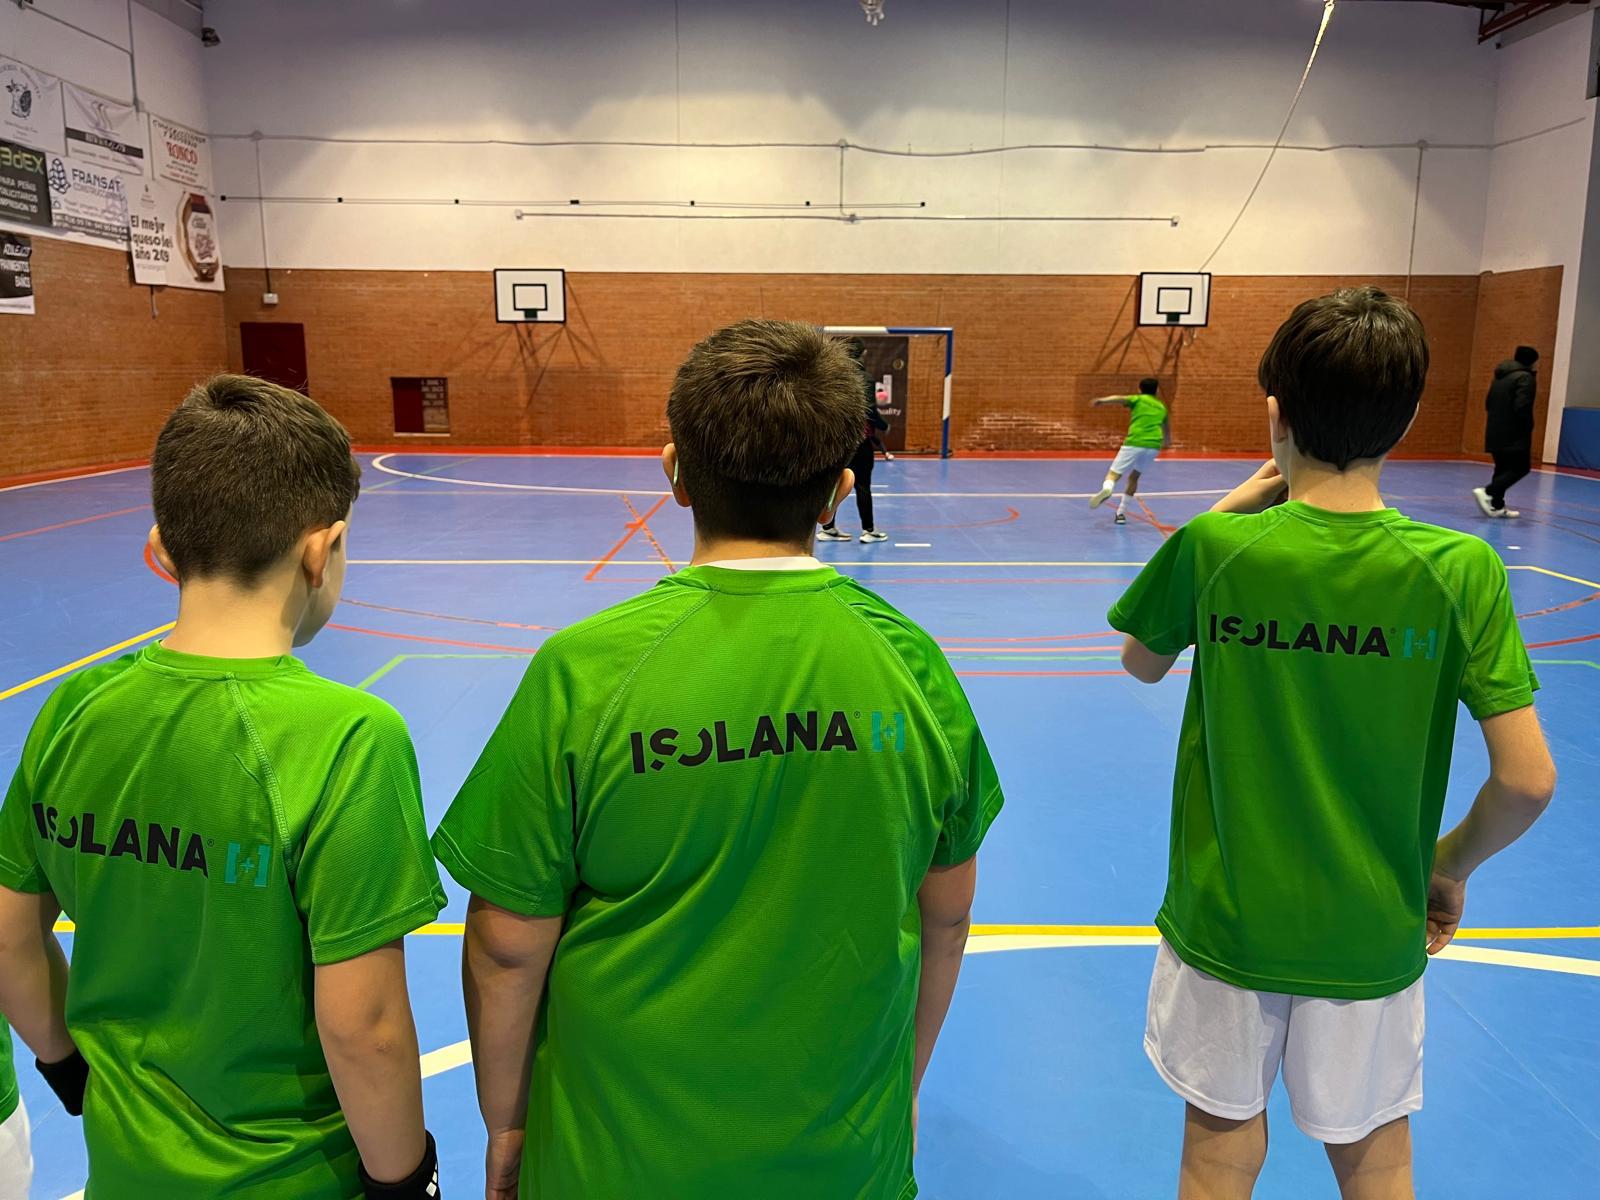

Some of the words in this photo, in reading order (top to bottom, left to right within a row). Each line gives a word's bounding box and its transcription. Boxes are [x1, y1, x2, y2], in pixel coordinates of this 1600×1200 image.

[72, 168, 121, 192] FRANSAT
[130, 215, 139, 228] El
[133, 234, 161, 247] queso
[135, 246, 151, 260] año
[877, 407, 901, 416] uality
[1209, 614, 1391, 658] ISOLANA
[630, 710, 858, 774] ISOLANA
